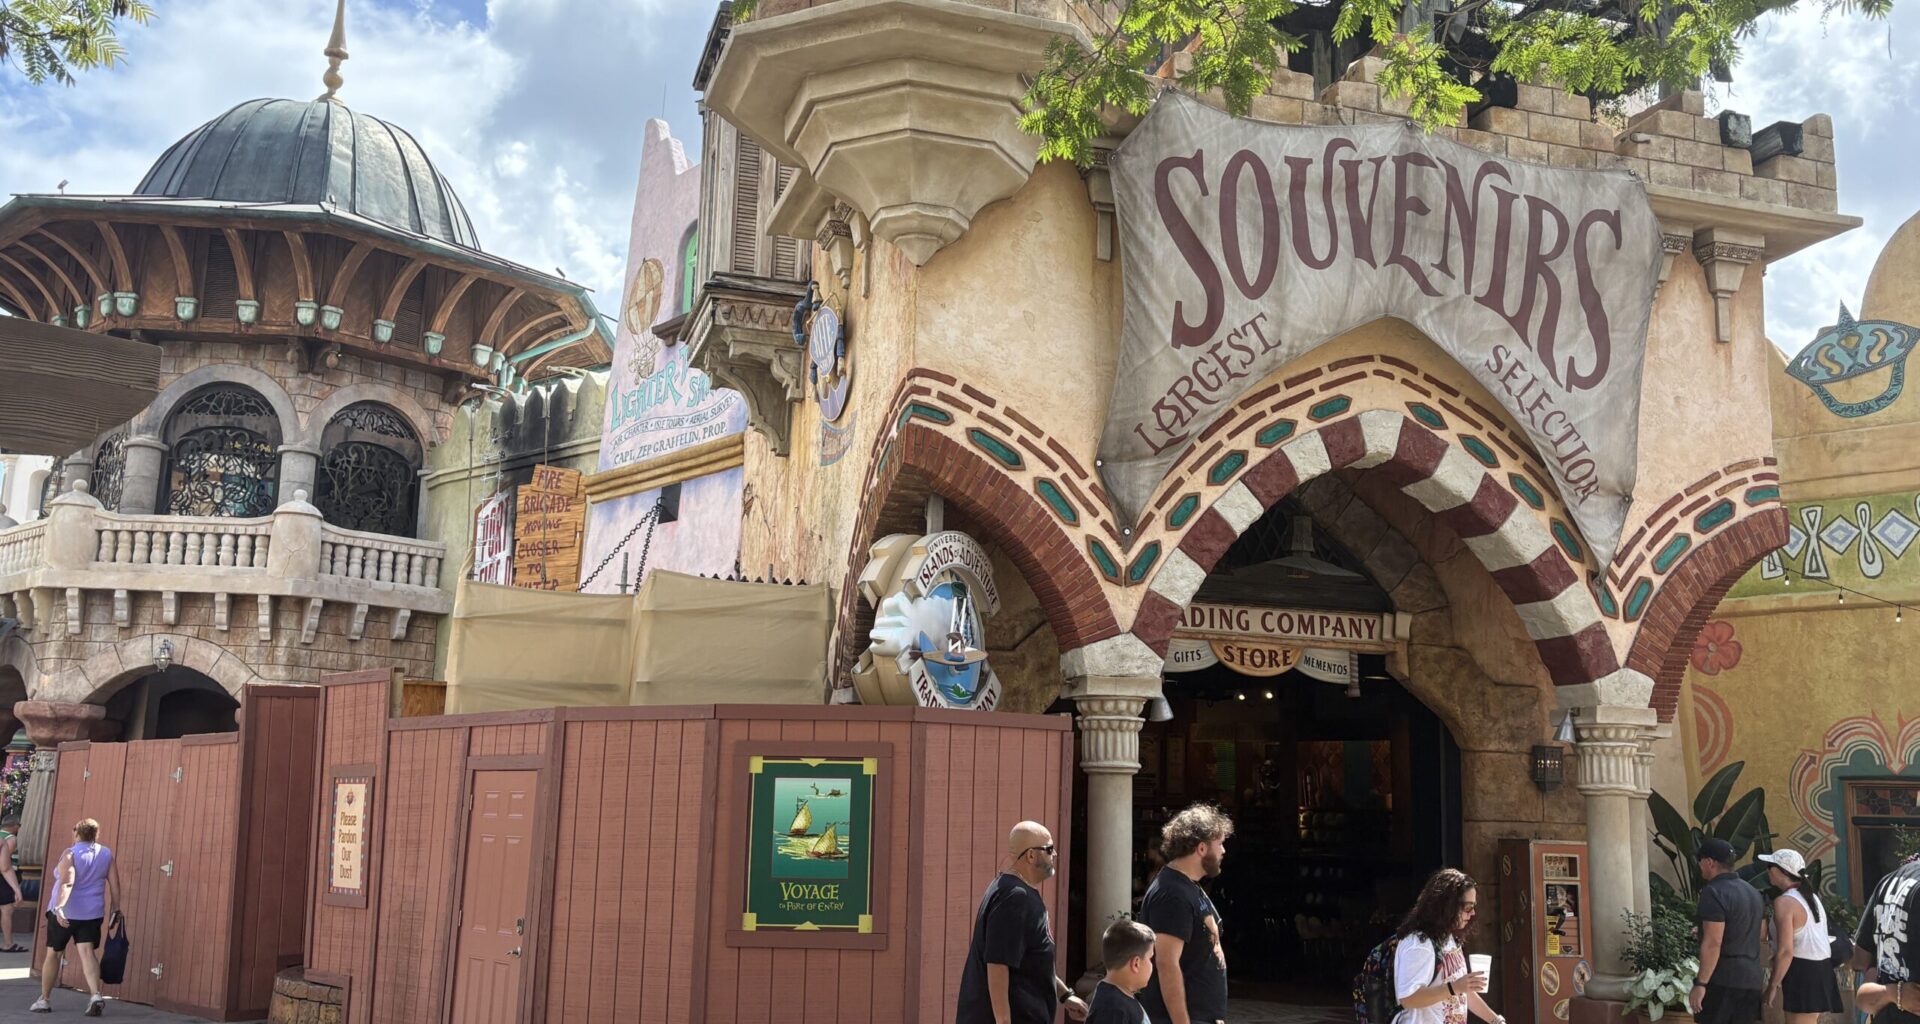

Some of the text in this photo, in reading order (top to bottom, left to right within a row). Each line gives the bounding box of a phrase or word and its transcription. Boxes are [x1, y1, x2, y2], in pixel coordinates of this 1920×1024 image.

[1154, 137, 1624, 394] SOUVENIRS
[611, 360, 683, 433] LIGHTER
[1133, 312, 1600, 506] LARGEST SELECTION
[612, 434, 623, 450] AIR
[624, 421, 649, 440] CHARTER
[689, 411, 709, 425] AERIAL
[703, 421, 728, 440] PROP.
[536, 469, 565, 490] FIRE
[523, 492, 573, 515] BRIGADE
[517, 540, 560, 560] CLOSER
[929, 534, 965, 553] UNIVERSAL
[527, 562, 541, 576] TO
[919, 544, 955, 589] ISLANDS
[959, 546, 998, 608] ADVENTURE
[1260, 610, 1377, 641] COMPANY
[1173, 644, 1348, 676] GIFTS STORE MEMENTOS
[339, 811, 357, 826] Please
[338, 829, 357, 844] Pardon
[341, 847, 352, 862] Our
[339, 864, 353, 879] Dust
[780, 881, 840, 900] VOYAGE
